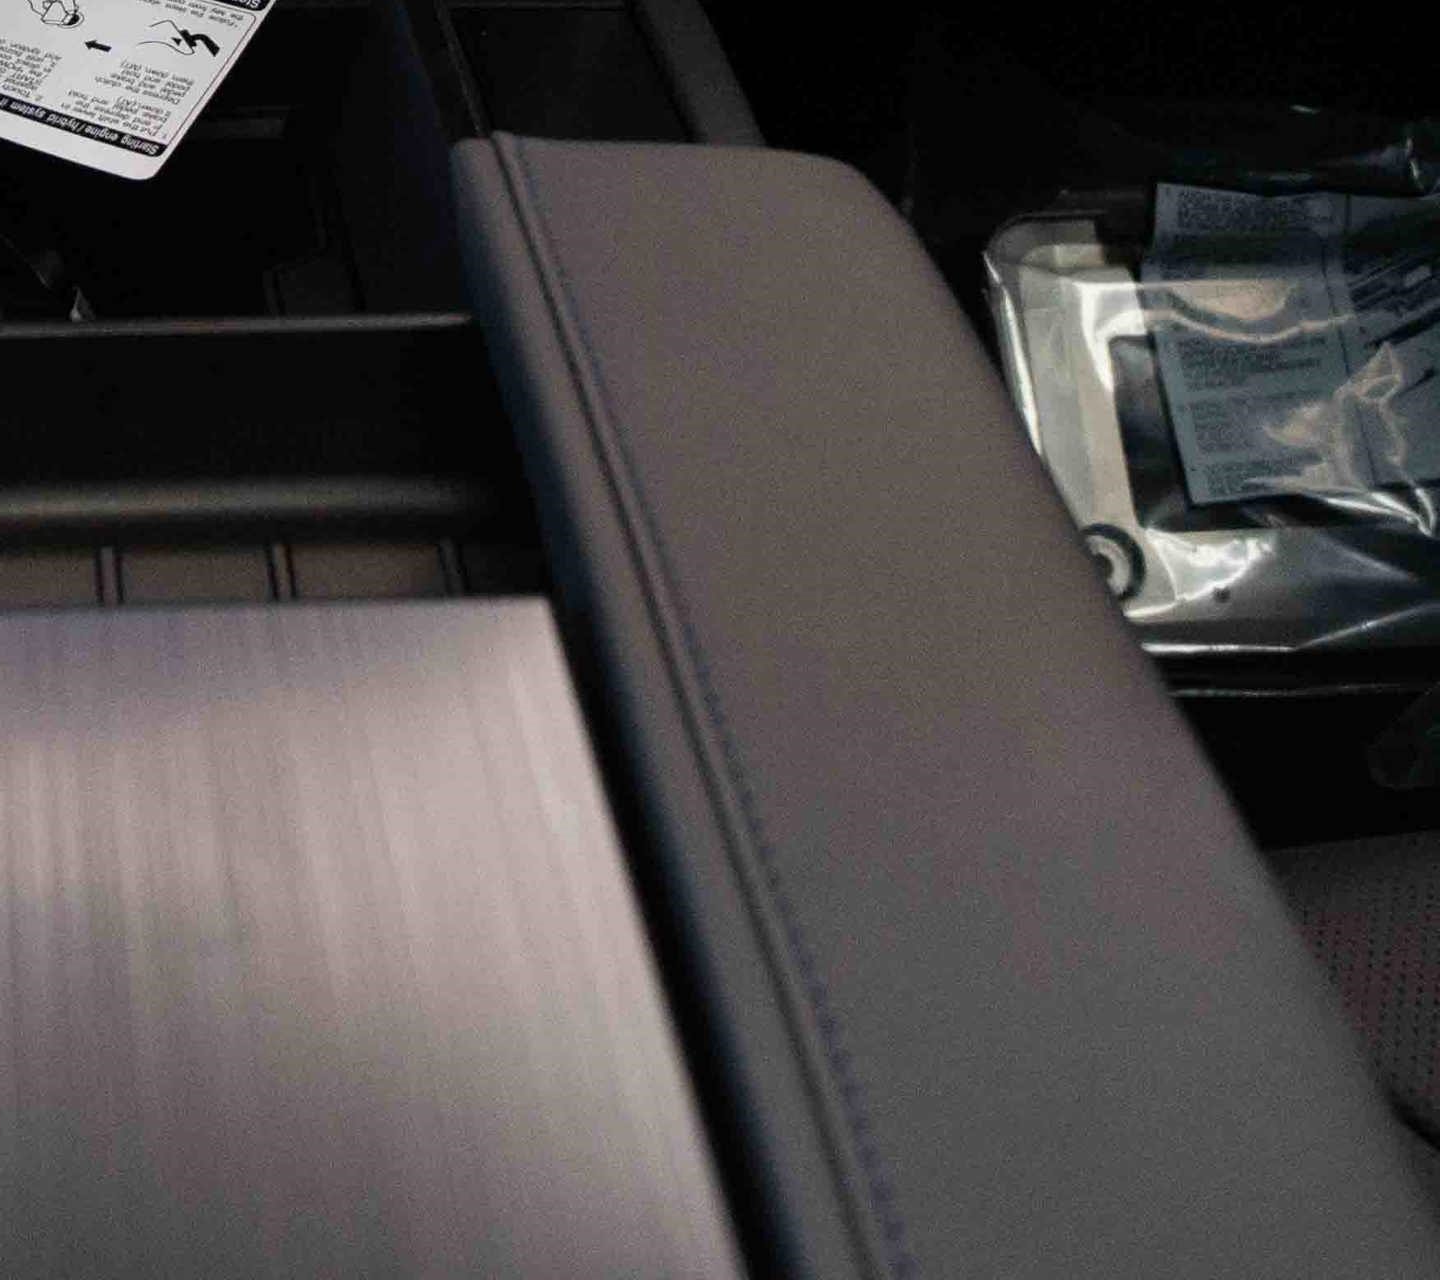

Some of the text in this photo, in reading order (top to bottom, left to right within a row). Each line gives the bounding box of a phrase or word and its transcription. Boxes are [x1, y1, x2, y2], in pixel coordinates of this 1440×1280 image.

[7, 98, 48, 120] system
[44, 110, 81, 132] hybrid
[81, 122, 120, 145] engine
[118, 133, 160, 156] Starting
